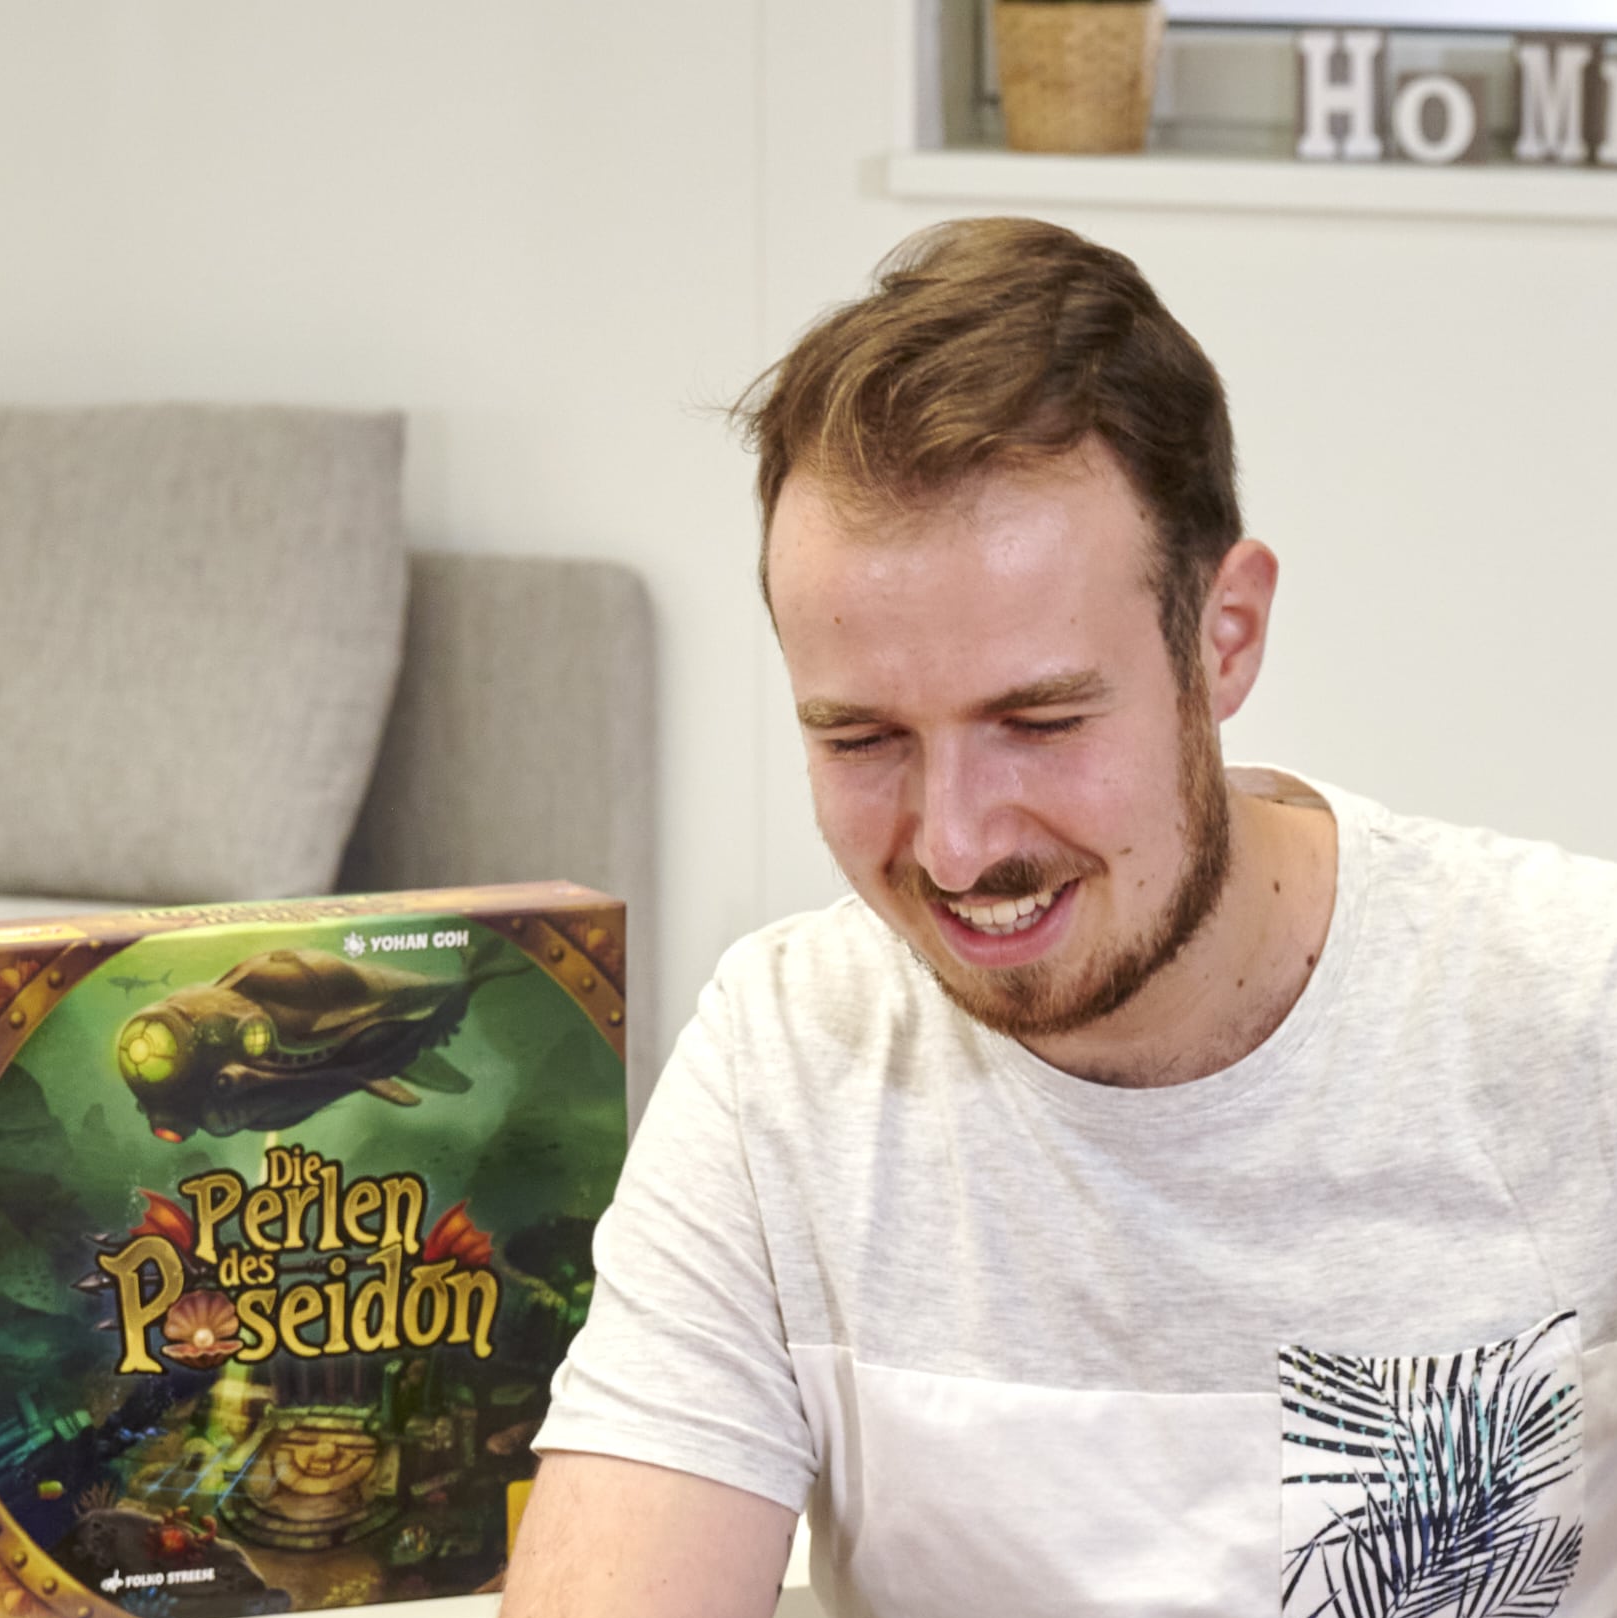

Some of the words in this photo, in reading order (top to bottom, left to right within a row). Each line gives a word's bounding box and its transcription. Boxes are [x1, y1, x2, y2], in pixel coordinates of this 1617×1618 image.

[370, 933, 428, 953] YOHAN
[432, 930, 470, 949] GOH
[267, 1147, 322, 1188] Die
[180, 1165, 422, 1264] Perlen
[218, 1252, 276, 1287] des
[124, 1573, 164, 1588] FOLKO
